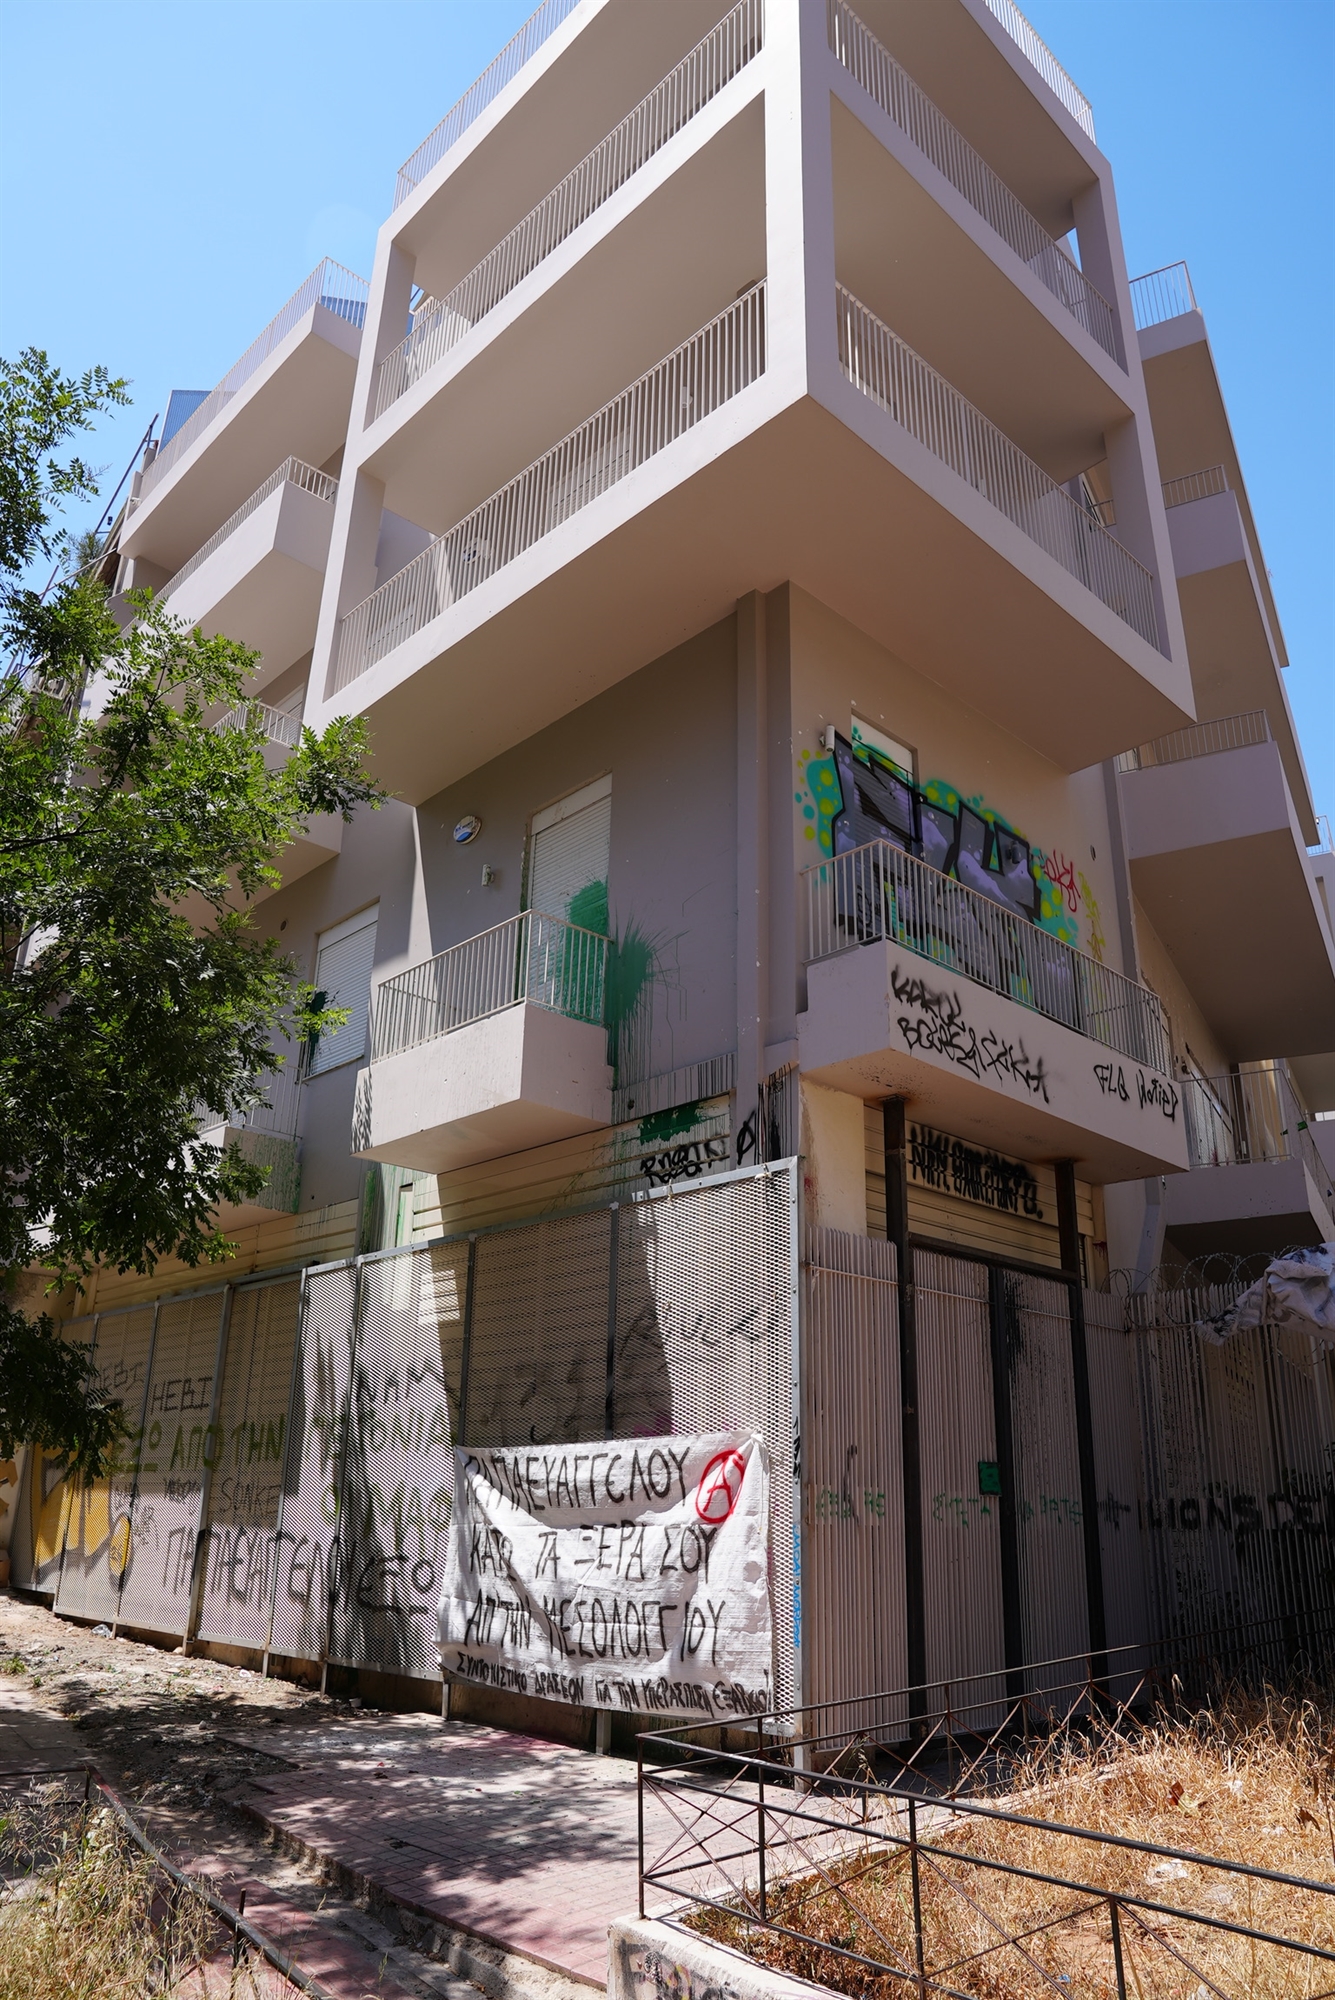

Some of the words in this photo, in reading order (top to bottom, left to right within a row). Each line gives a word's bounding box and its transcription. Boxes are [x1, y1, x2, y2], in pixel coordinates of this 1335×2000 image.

[535, 1530, 561, 1580] ΤΑ
[573, 1519, 648, 1581] ΞΕΡΑ
[659, 1523, 718, 1584] ΣΟΥ
